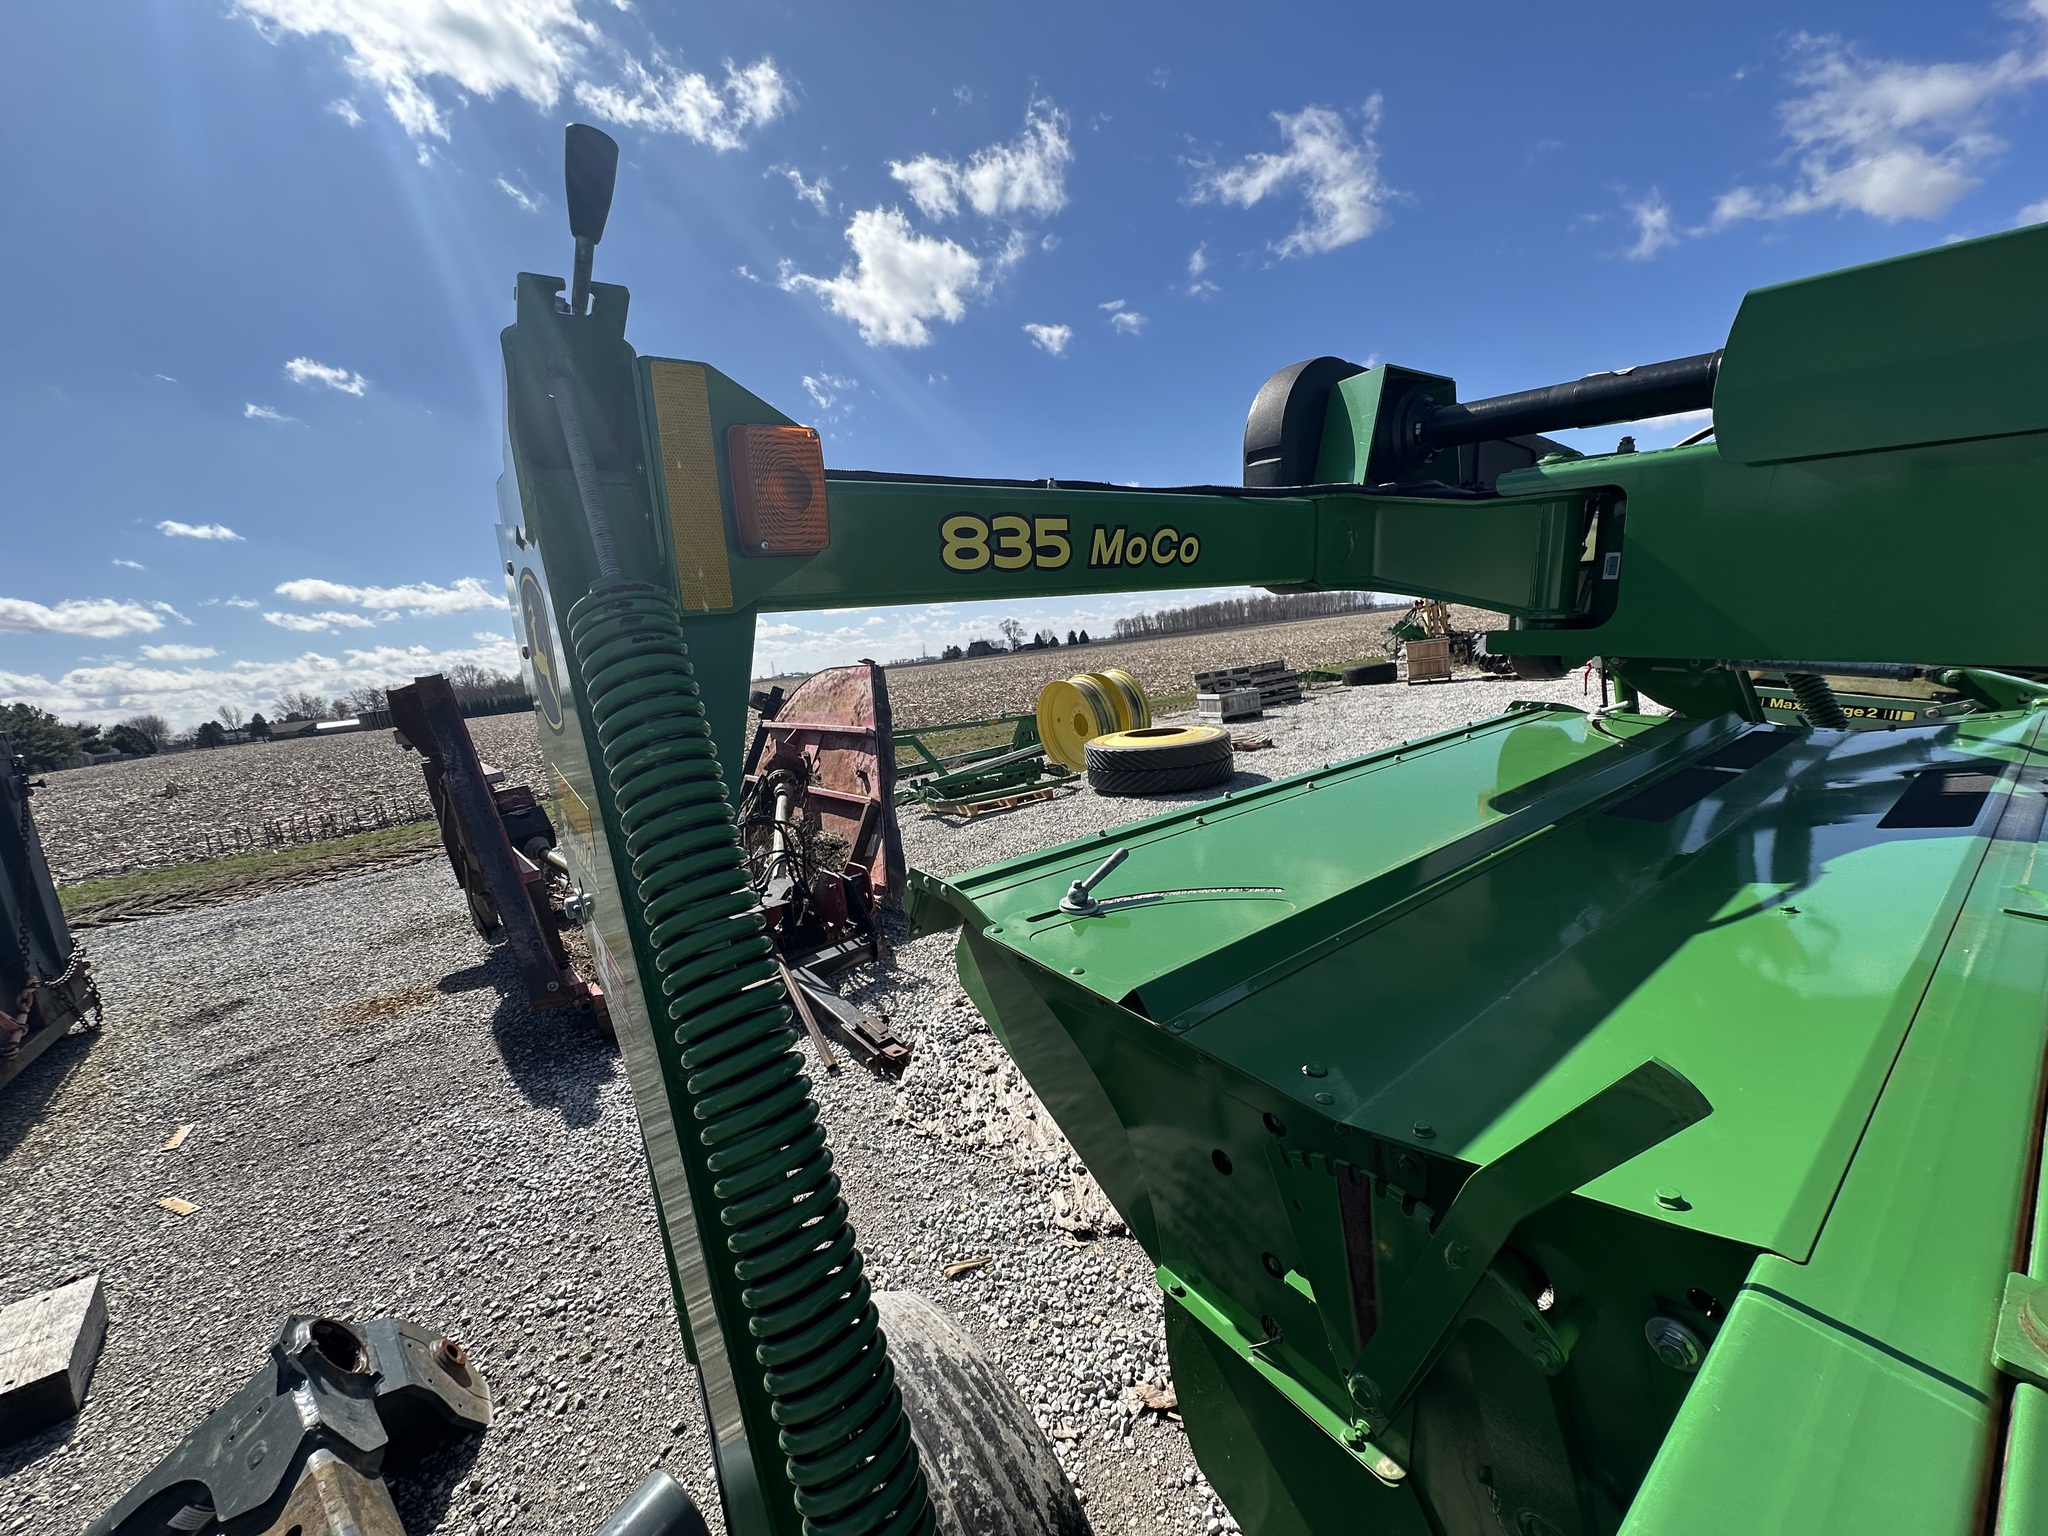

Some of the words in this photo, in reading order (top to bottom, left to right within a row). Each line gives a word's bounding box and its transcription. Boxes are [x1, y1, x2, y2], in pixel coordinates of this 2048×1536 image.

[940, 514, 1072, 571] 835
[1089, 526, 1201, 567] MoCo
[1769, 697, 1865, 718] Maxge
[1866, 707, 1878, 719] 2
